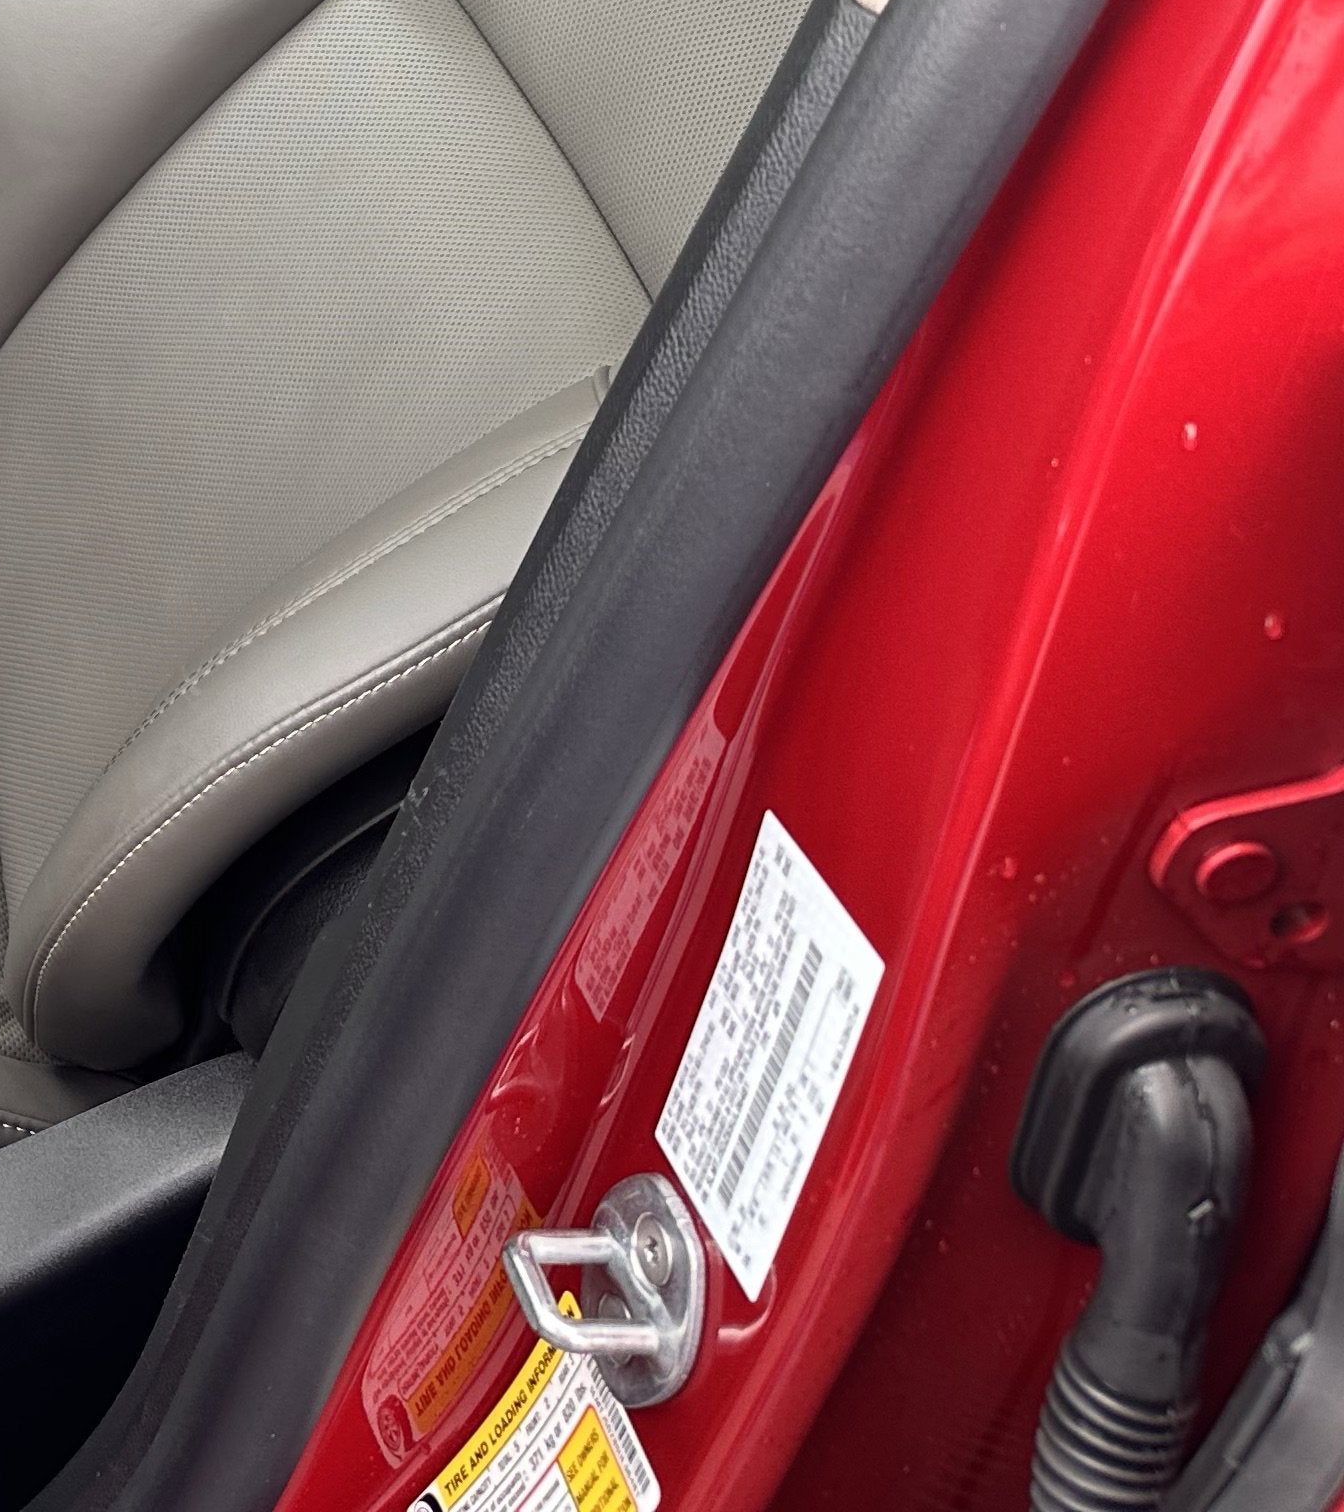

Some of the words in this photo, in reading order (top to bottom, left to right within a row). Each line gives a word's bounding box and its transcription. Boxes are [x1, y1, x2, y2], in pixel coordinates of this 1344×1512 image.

[444, 1464, 470, 1497] TIRE
[469, 1441, 490, 1472] AND
[488, 1389, 528, 1446] LOADING
